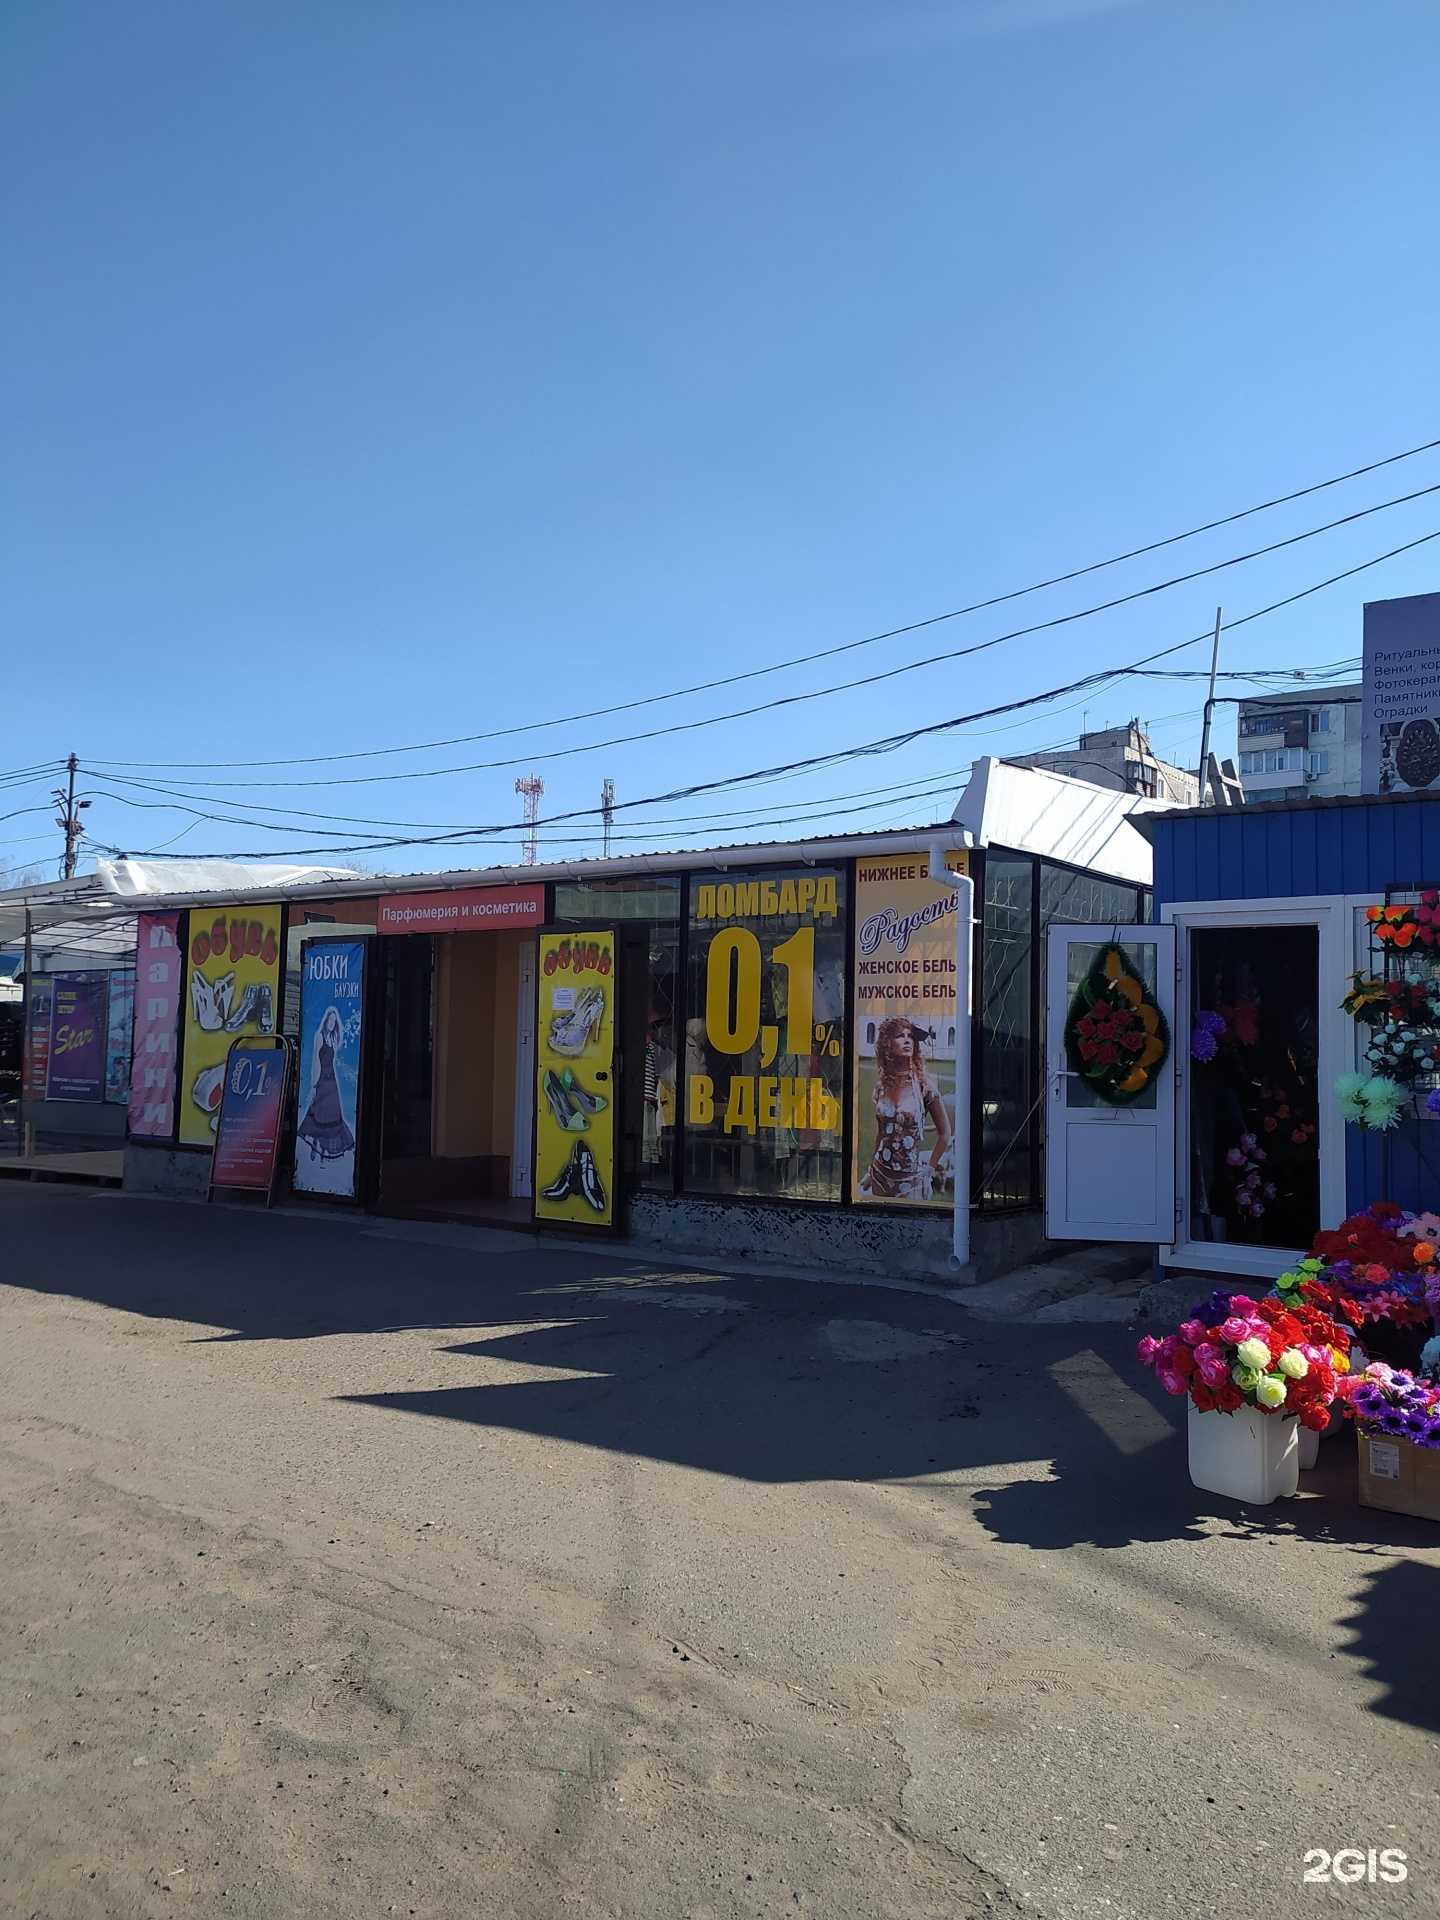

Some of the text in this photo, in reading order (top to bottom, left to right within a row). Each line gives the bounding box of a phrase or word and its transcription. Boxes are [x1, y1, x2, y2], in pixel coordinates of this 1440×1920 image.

[1374, 705, 1428, 719] Оградки
[858, 862, 965, 883] НИЖНЕЕ БЬЕ
[696, 876, 838, 919] ЛОМБАРД
[382, 900, 537, 923] Парфюмерия и косметика
[309, 954, 349, 980] ЮБКИ
[858, 959, 957, 975] ЖЕНСКОЕ БЕЛЬ
[858, 984, 957, 1000] МУЖСКОЕ БЕЛЬ
[689, 1074, 838, 1135] В ДЕНЬ
